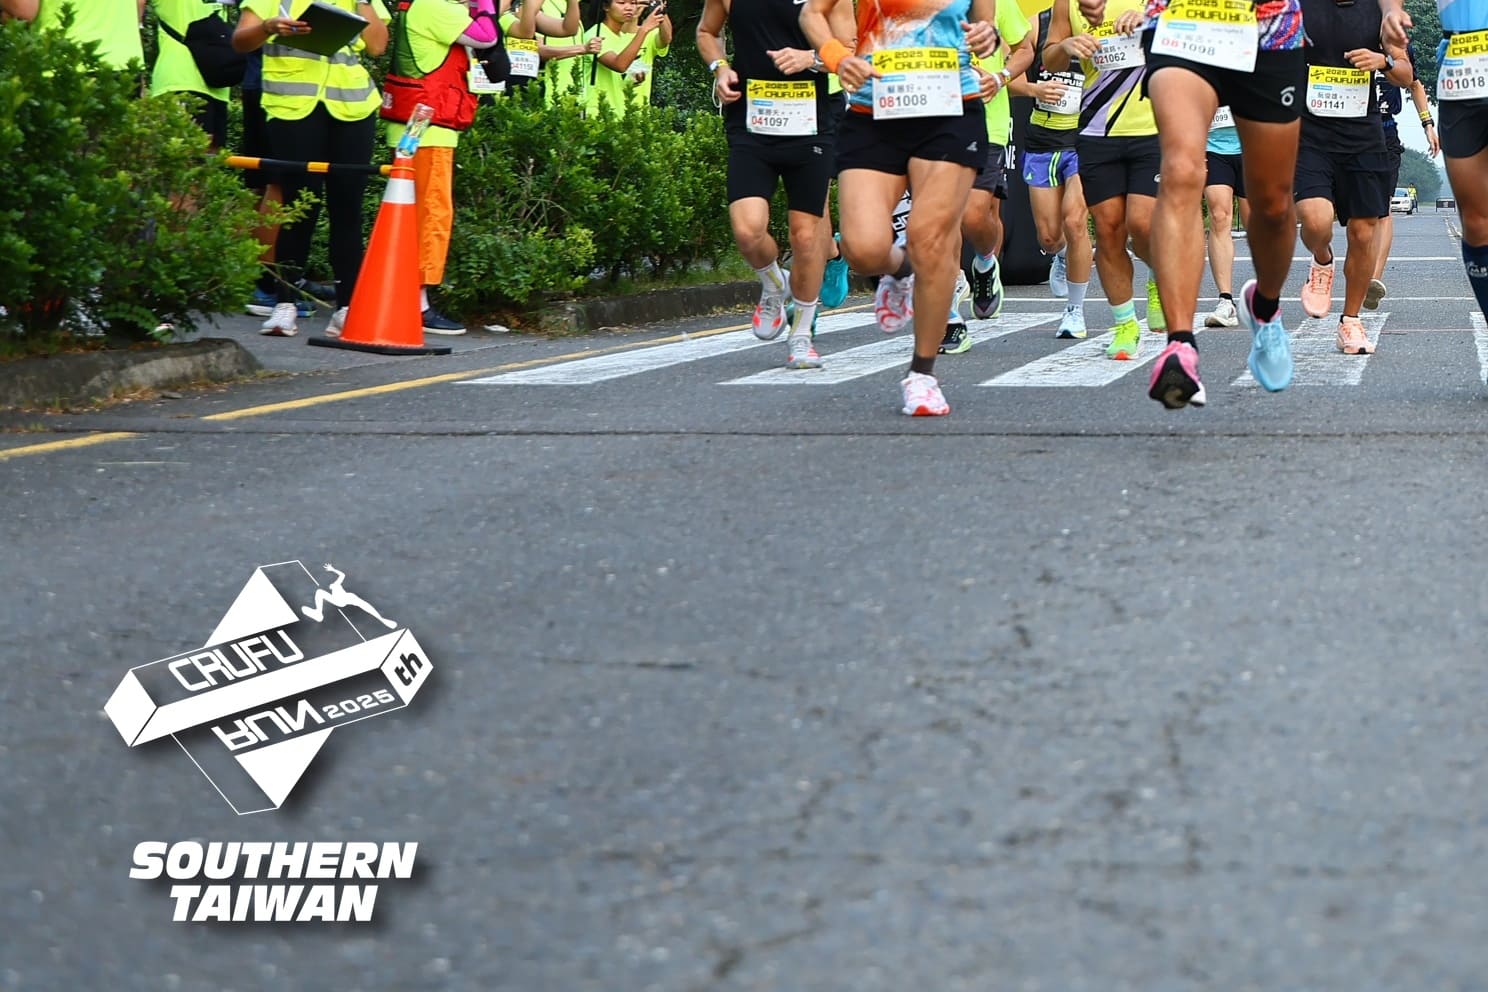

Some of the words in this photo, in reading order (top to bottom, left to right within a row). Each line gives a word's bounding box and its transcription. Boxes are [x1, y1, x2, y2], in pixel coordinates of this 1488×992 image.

[1452, 34, 1479, 45] 2025
[894, 51, 923, 59] 2025
[1094, 52, 1126, 64] 021062
[1441, 76, 1485, 90] 101018
[879, 94, 928, 108] 081008
[1311, 99, 1344, 109] 091141
[752, 116, 789, 126] 041097
